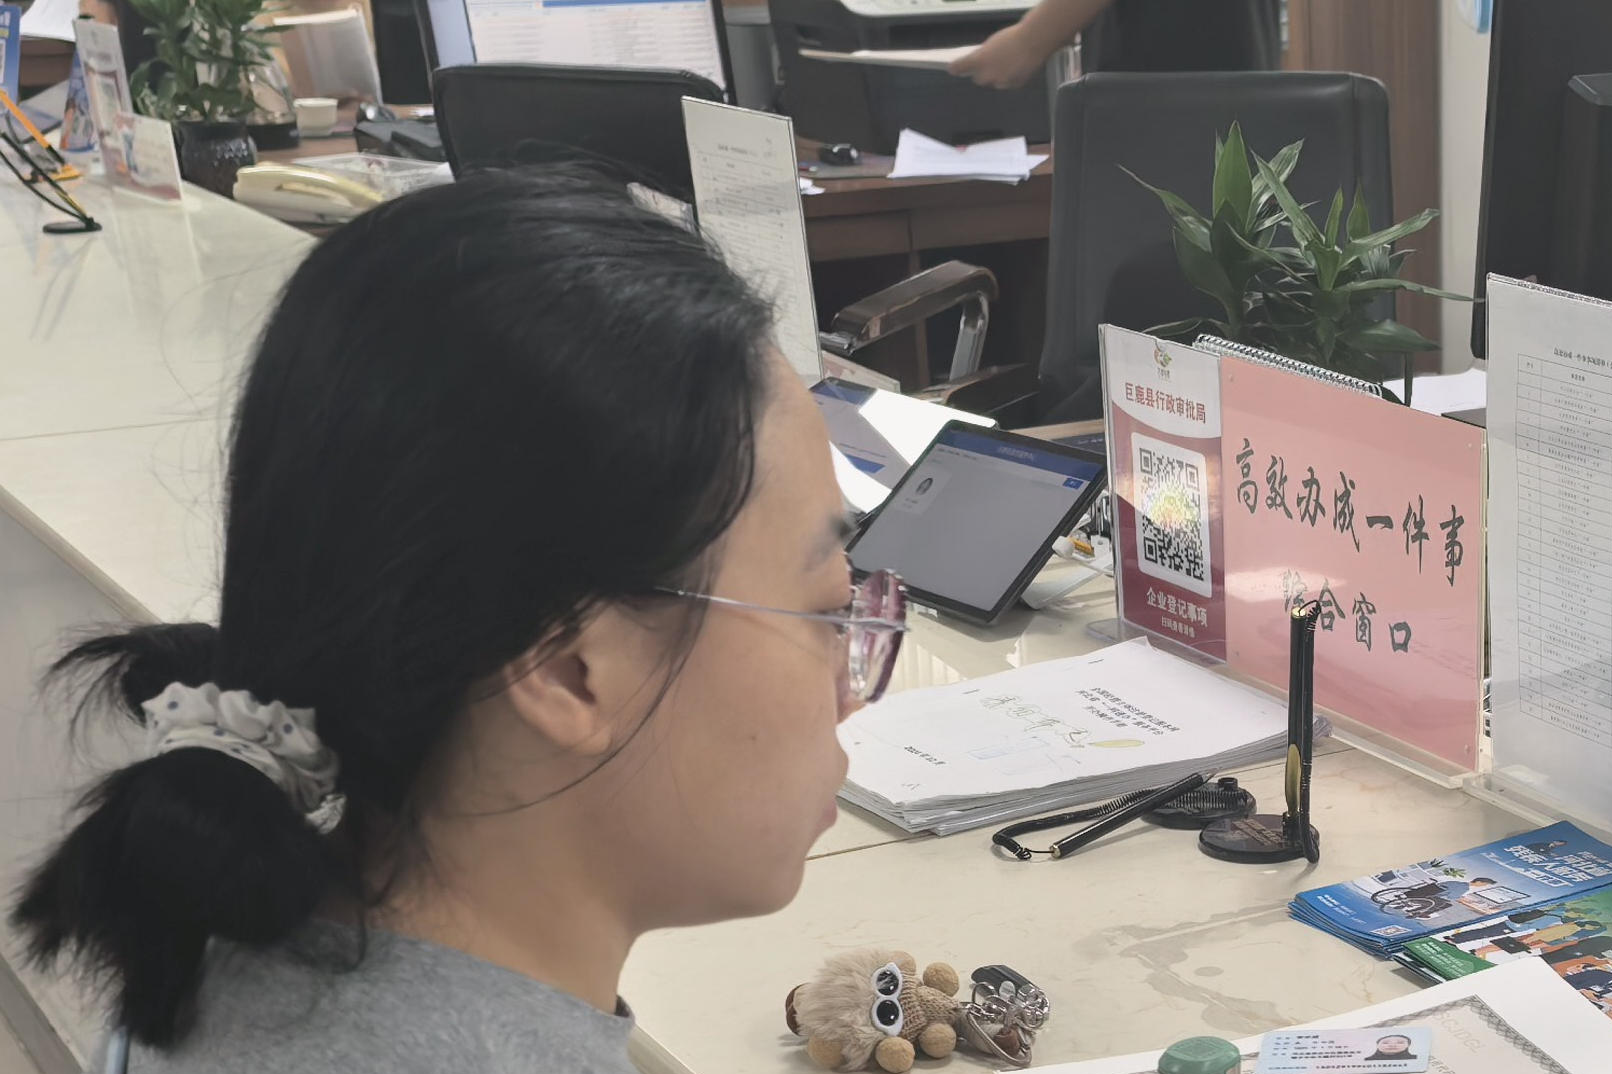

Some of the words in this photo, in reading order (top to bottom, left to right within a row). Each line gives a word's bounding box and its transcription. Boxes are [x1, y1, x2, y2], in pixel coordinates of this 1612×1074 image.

[1125, 382, 1206, 424] 巨鹿县行政审批局
[1236, 438, 1465, 587] 高效办成一件事
[1146, 586, 1208, 628] 企业登记事项
